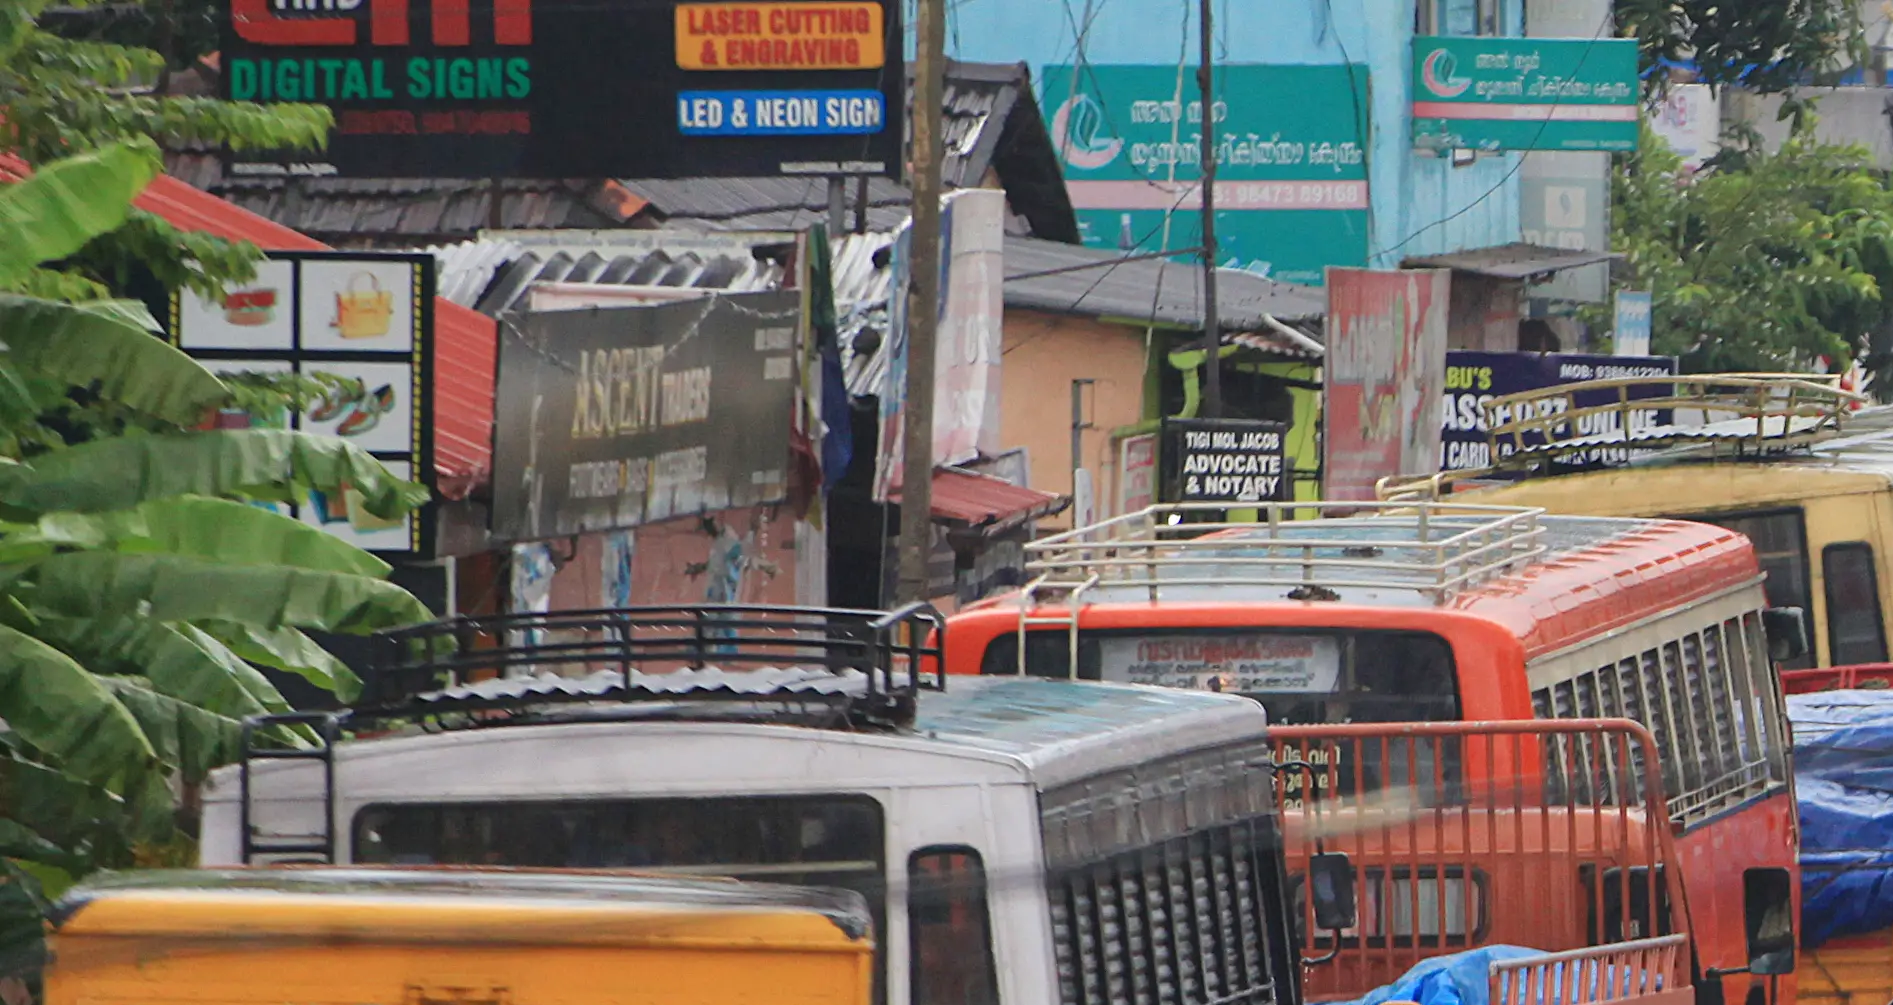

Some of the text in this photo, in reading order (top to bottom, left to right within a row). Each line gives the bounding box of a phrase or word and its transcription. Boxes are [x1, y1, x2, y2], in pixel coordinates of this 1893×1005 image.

[687, 7, 870, 35] LASER CUTTING
[700, 38, 860, 66] & ENGRAVING
[230, 56, 532, 99] DIGITAL SIGNS
[679, 97, 880, 128] LED & NEON SIGN
[1446, 366, 1493, 390] BU'S
[1559, 363, 1594, 379] MOB:
[571, 345, 664, 439] ASCENT
[1441, 394, 1659, 435] ASSPORT ONLNE
[1185, 431, 1279, 450] TIGI MOL JACOB
[1183, 453, 1281, 475] ADVOCATE
[1185, 475, 1280, 496] & NOTARY
